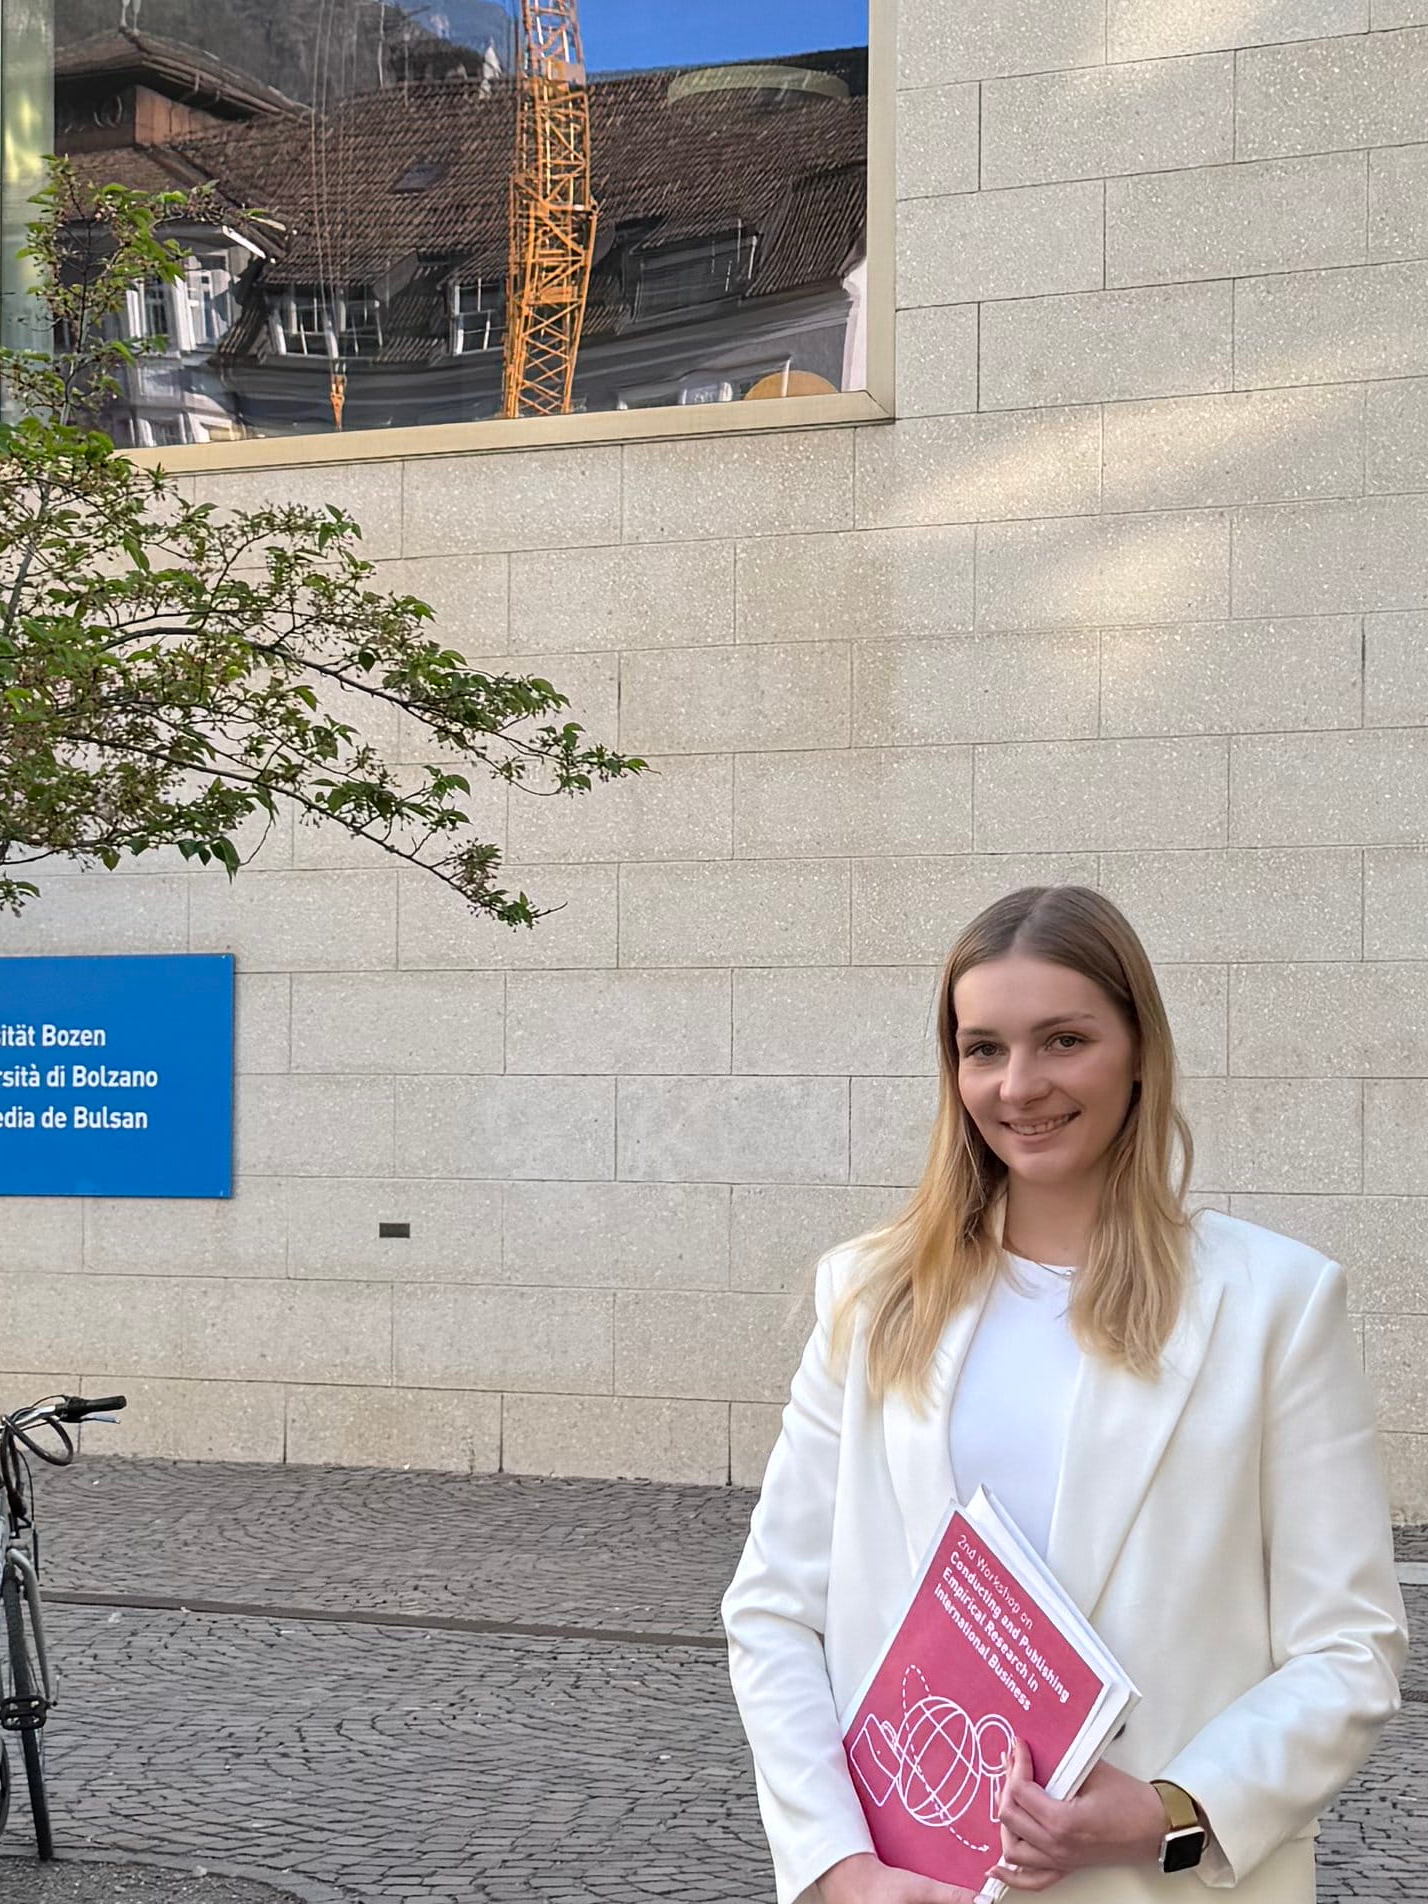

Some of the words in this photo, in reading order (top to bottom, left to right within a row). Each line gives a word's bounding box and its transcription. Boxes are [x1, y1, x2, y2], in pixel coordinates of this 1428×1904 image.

[41, 1024, 107, 1047] Bozen
[46, 1065, 66, 1088] di
[72, 1065, 159, 1088] Bolzano
[41, 1106, 68, 1129] de
[73, 1106, 149, 1129] Bulsan
[942, 1566, 986, 1627] Empirical
[984, 1620, 1029, 1679] Research
[1027, 1673, 1039, 1693] in
[950, 1551, 1002, 1619] Conducting
[1000, 1615, 1022, 1641] and
[1018, 1635, 1070, 1704] Publishing
[976, 1555, 1021, 1614] Workshop
[1020, 1612, 1034, 1630] on
[934, 1583, 991, 1661] International
[987, 1653, 1032, 1712] Business
